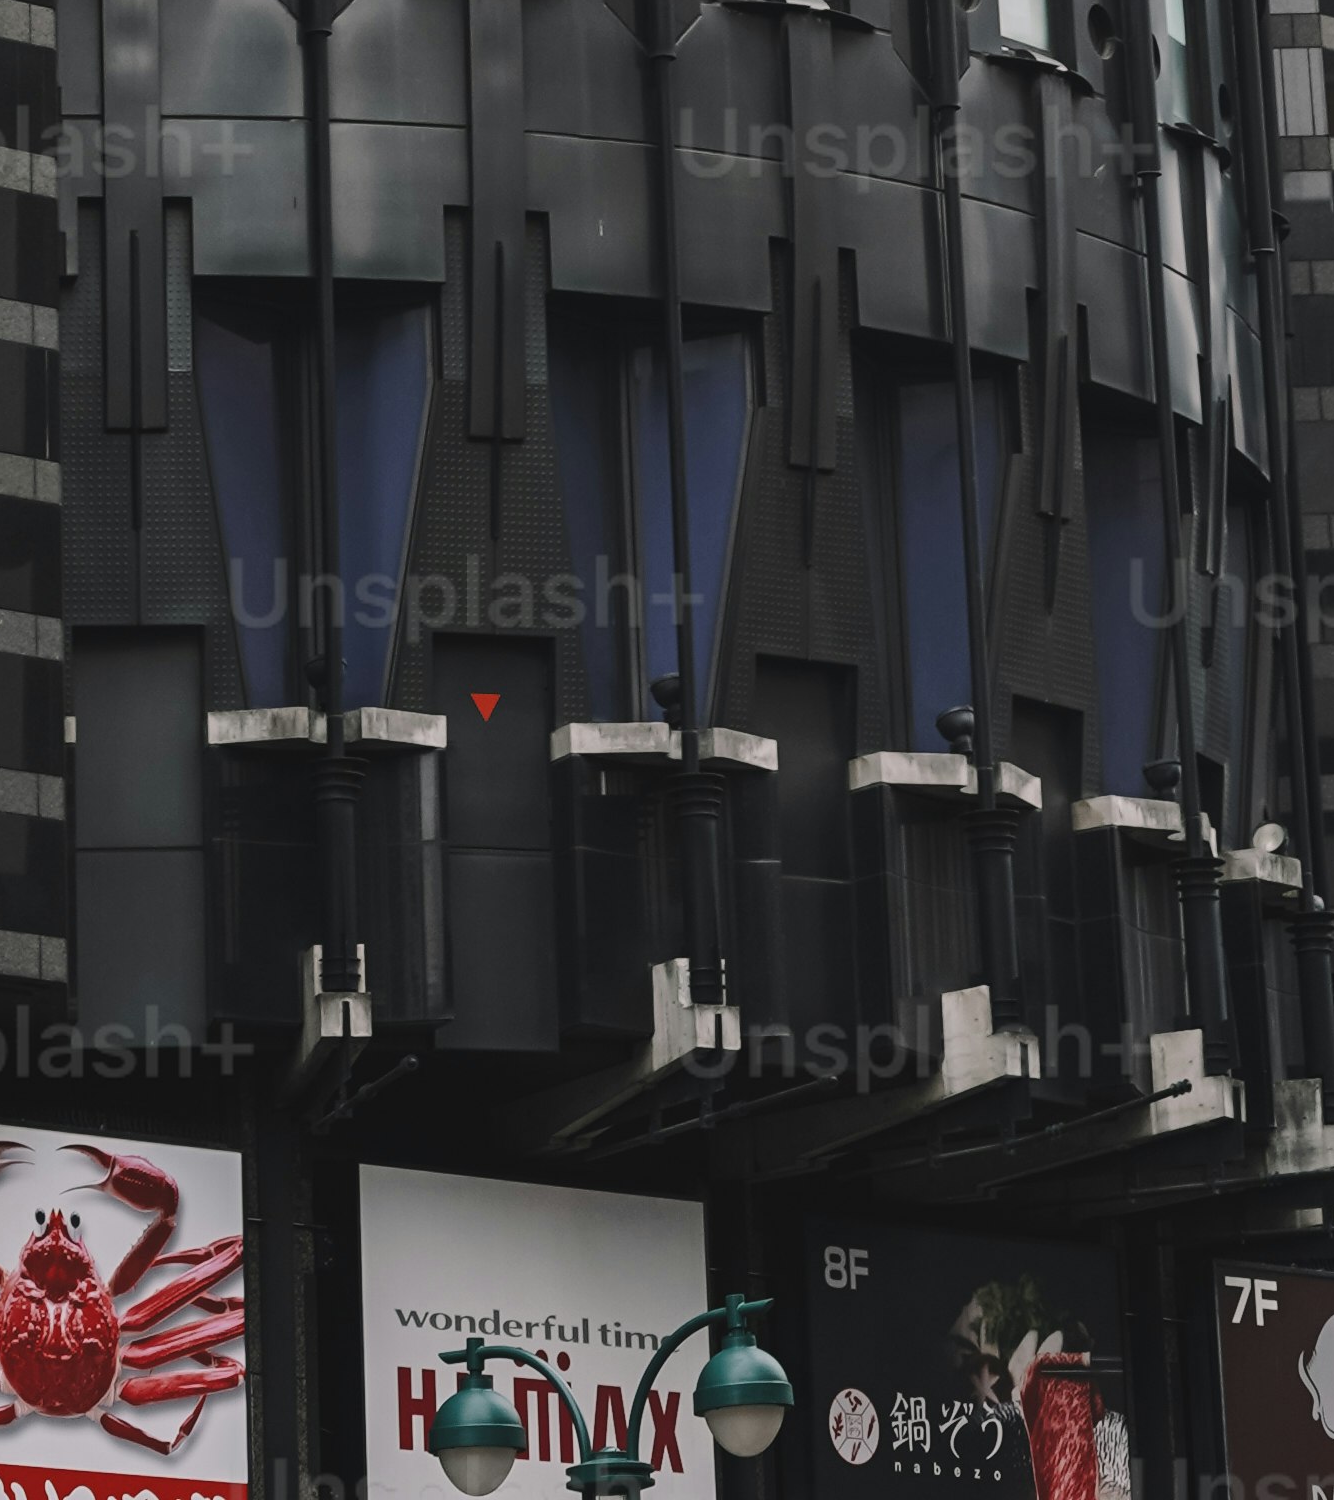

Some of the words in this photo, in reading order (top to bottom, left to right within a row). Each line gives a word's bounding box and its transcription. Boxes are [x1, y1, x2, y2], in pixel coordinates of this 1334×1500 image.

[823, 1245, 870, 1291] 8F
[1224, 1275, 1279, 1327] 7F
[394, 1307, 590, 1345] wonderful
[598, 1322, 680, 1353] tim
[889, 1391, 1004, 1461] 鍋ぞう
[894, 1460, 1003, 1481] nabezo
